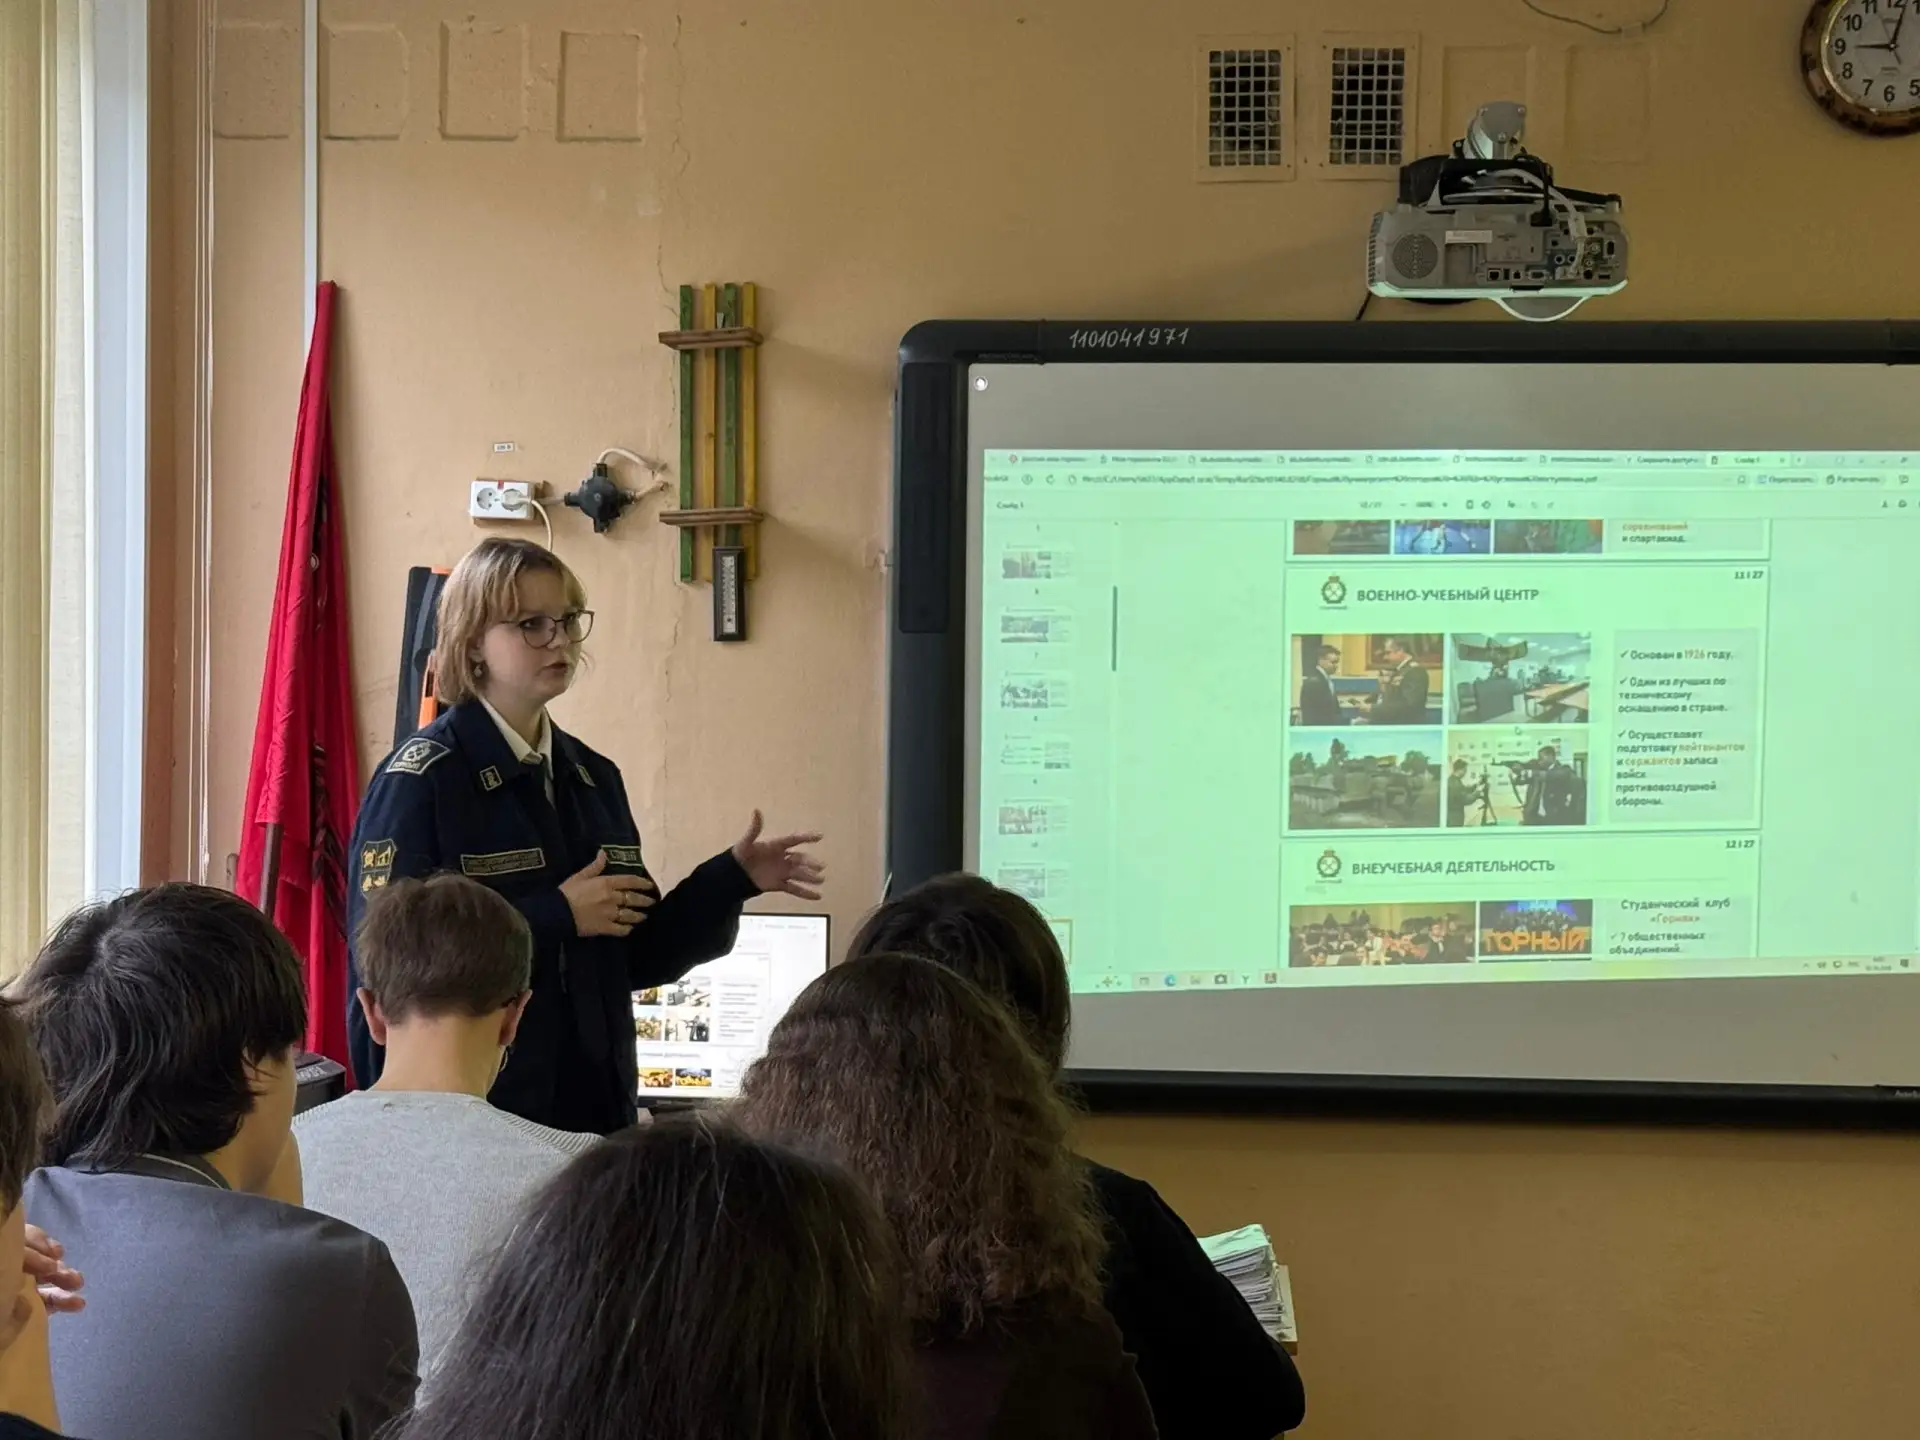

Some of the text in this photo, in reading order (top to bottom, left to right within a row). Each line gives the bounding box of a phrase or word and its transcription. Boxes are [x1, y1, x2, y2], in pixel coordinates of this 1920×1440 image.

[1842, 14, 1863, 32] 10
[1834, 38, 1846, 55] 9
[1842, 62, 1853, 79] 8
[1862, 79, 1874, 96] 7
[1883, 85, 1896, 103] 6
[1909, 79, 1920, 96] 5
[1357, 586, 1539, 603] ВОЕННО-УЧЕБНЫЙ ЦЕНТР
[1630, 650, 1675, 660] Основан
[1684, 649, 1705, 660] 1926
[1618, 704, 1680, 713] оснащению
[1617, 744, 1678, 755] подготовку
[1616, 768, 1647, 779] войск
[1616, 780, 1717, 794] противовоздушной
[1352, 860, 1556, 876] ВНЕУЧЕБНАЯ ДЕЯТЕЛЬНОСТЬ
[1621, 898, 1731, 911] Студенческий клуб
[1485, 929, 1585, 953] ГОРНЫЙ
[1628, 932, 1706, 942] общественных
